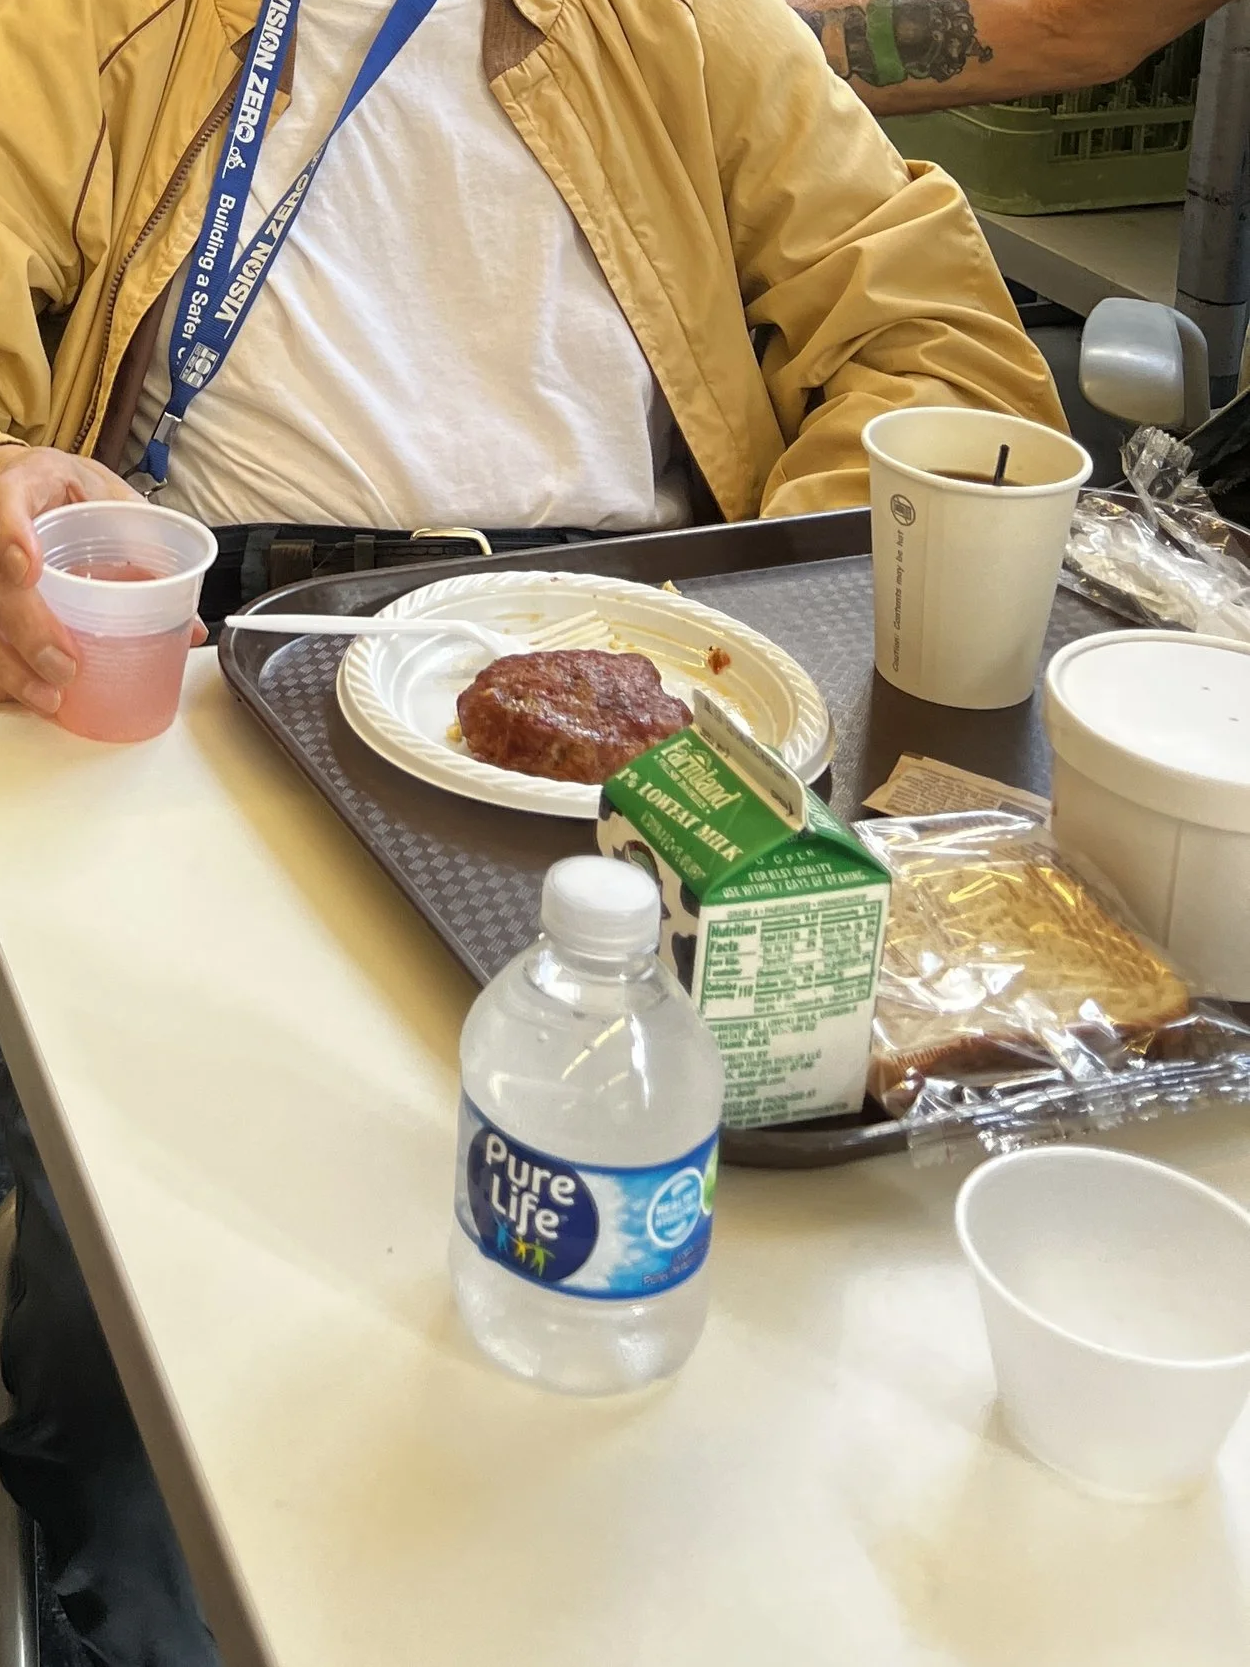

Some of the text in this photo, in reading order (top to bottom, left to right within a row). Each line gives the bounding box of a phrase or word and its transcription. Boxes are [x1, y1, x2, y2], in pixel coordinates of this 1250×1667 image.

[236, 72, 269, 143] ZERO
[198, 193, 236, 271] Building
[214, 173, 310, 323] VISION ZERO
[196, 274, 210, 287] a
[895, 550, 903, 562] be
[896, 565, 905, 585] may
[893, 587, 902, 631] Contents
[892, 633, 900, 673] Caution:
[660, 738, 742, 810] Farmland
[616, 768, 640, 788] 1%
[636, 781, 702, 829] LOWFAT
[693, 824, 744, 862] MILK
[722, 886, 741, 899] USE
[741, 881, 776, 896] WITHIN
[785, 877, 810, 891] DAYS
[810, 875, 823, 887] OF
[748, 862, 833, 883] FOR BEST QUALITY
[710, 922, 757, 938] Nutrition
[710, 940, 739, 954] Facts
[485, 1133, 577, 1207] Pure
[491, 1173, 561, 1240] Life
